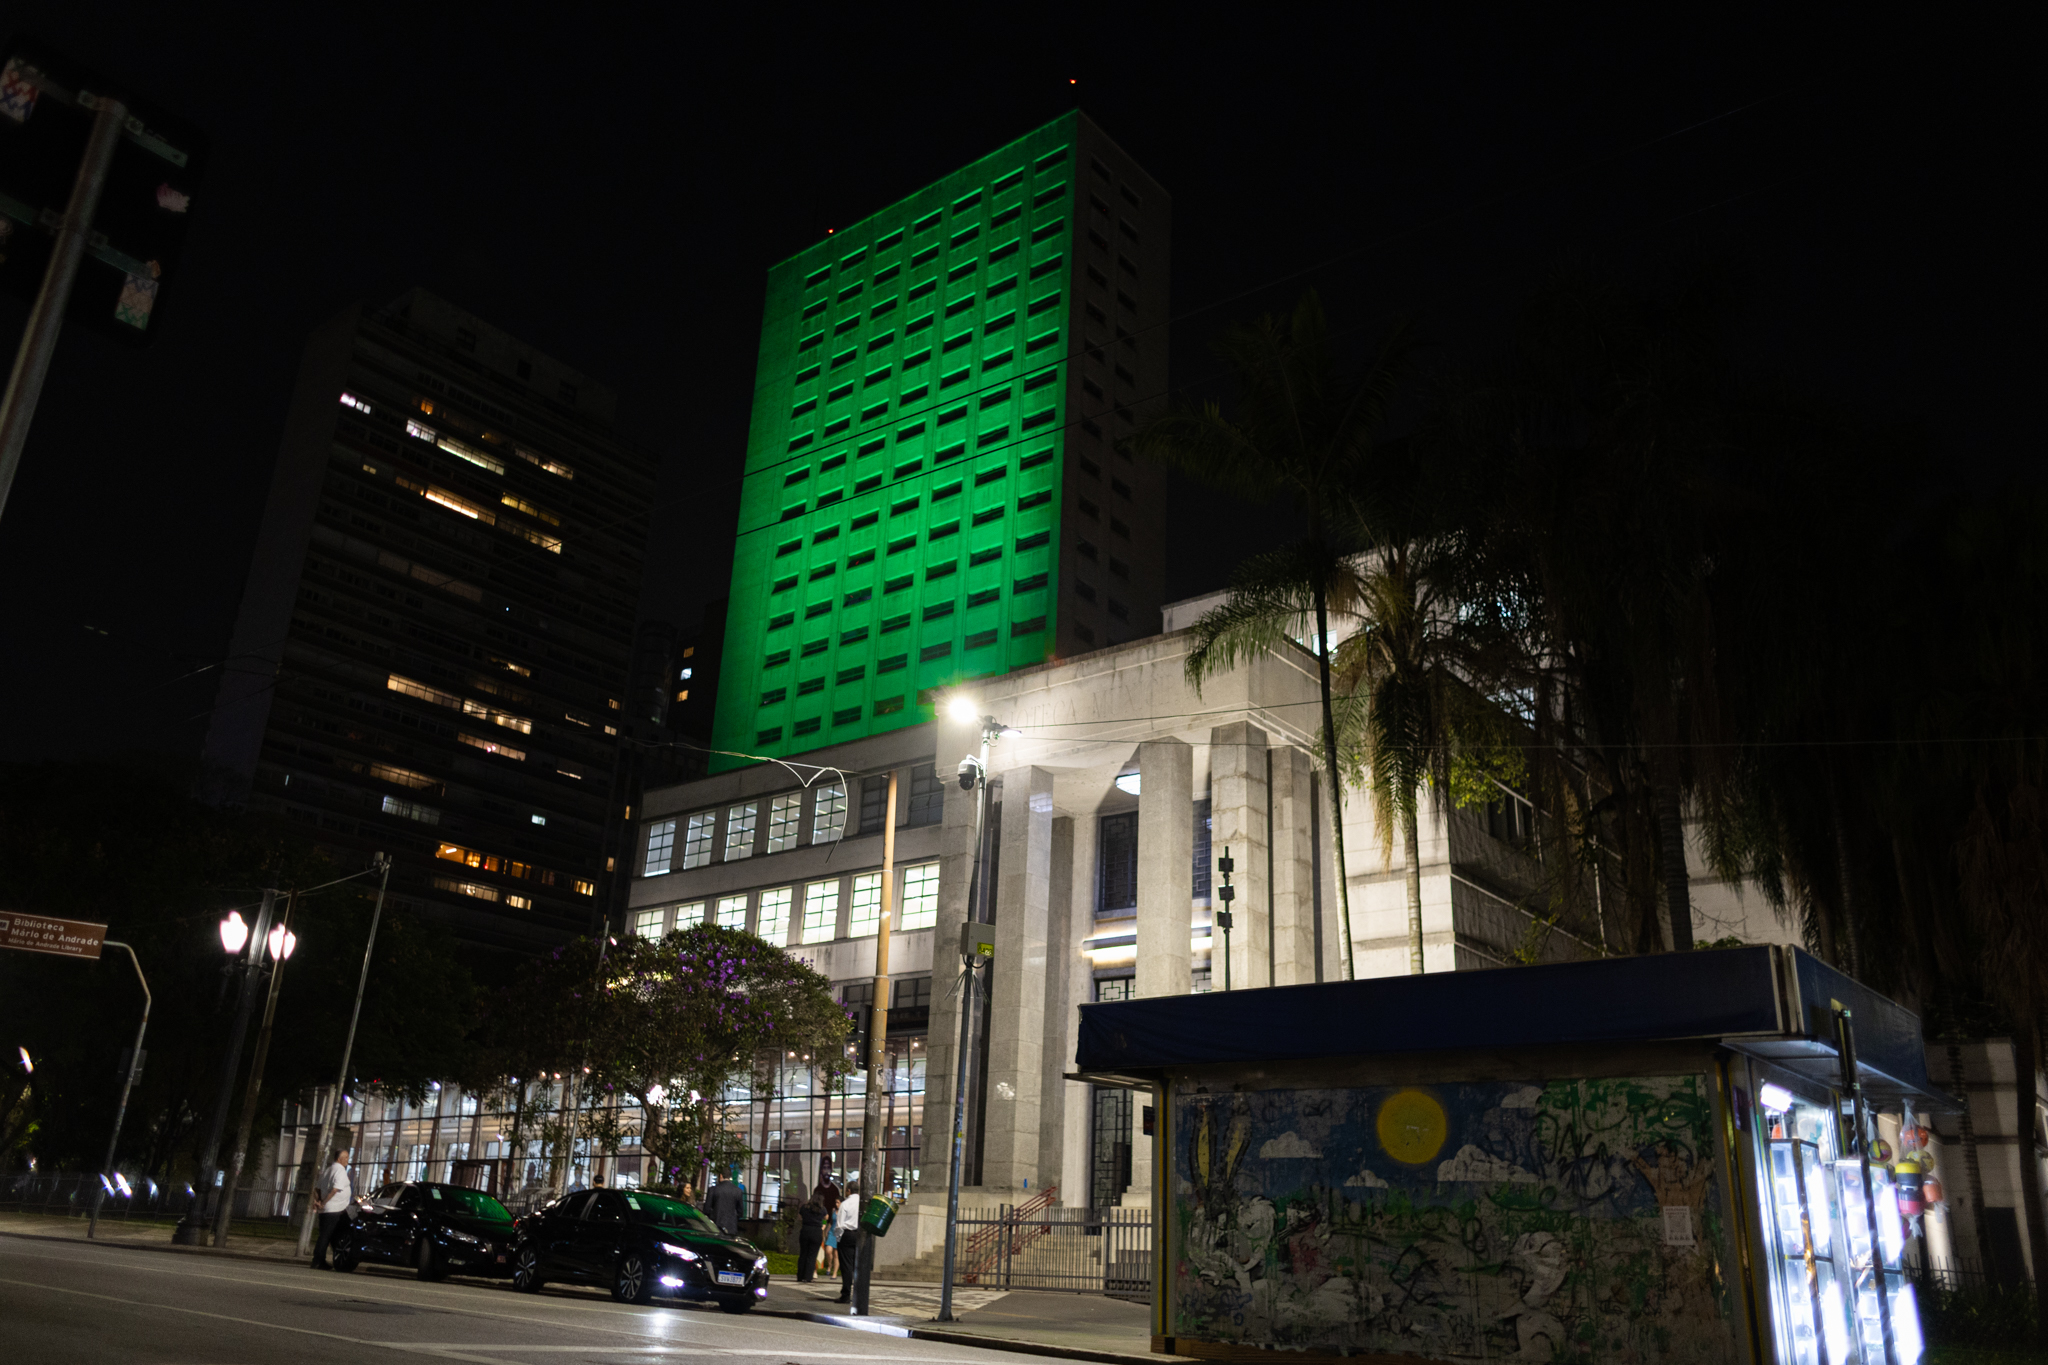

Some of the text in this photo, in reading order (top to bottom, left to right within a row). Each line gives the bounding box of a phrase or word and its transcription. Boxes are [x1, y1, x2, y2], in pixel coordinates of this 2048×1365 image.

[14, 918, 64, 932] Biblioteca
[11, 928, 99, 946] Mário de Andrade
[35, 941, 60, 949] Andrade
[61, 945, 82, 953] Library
